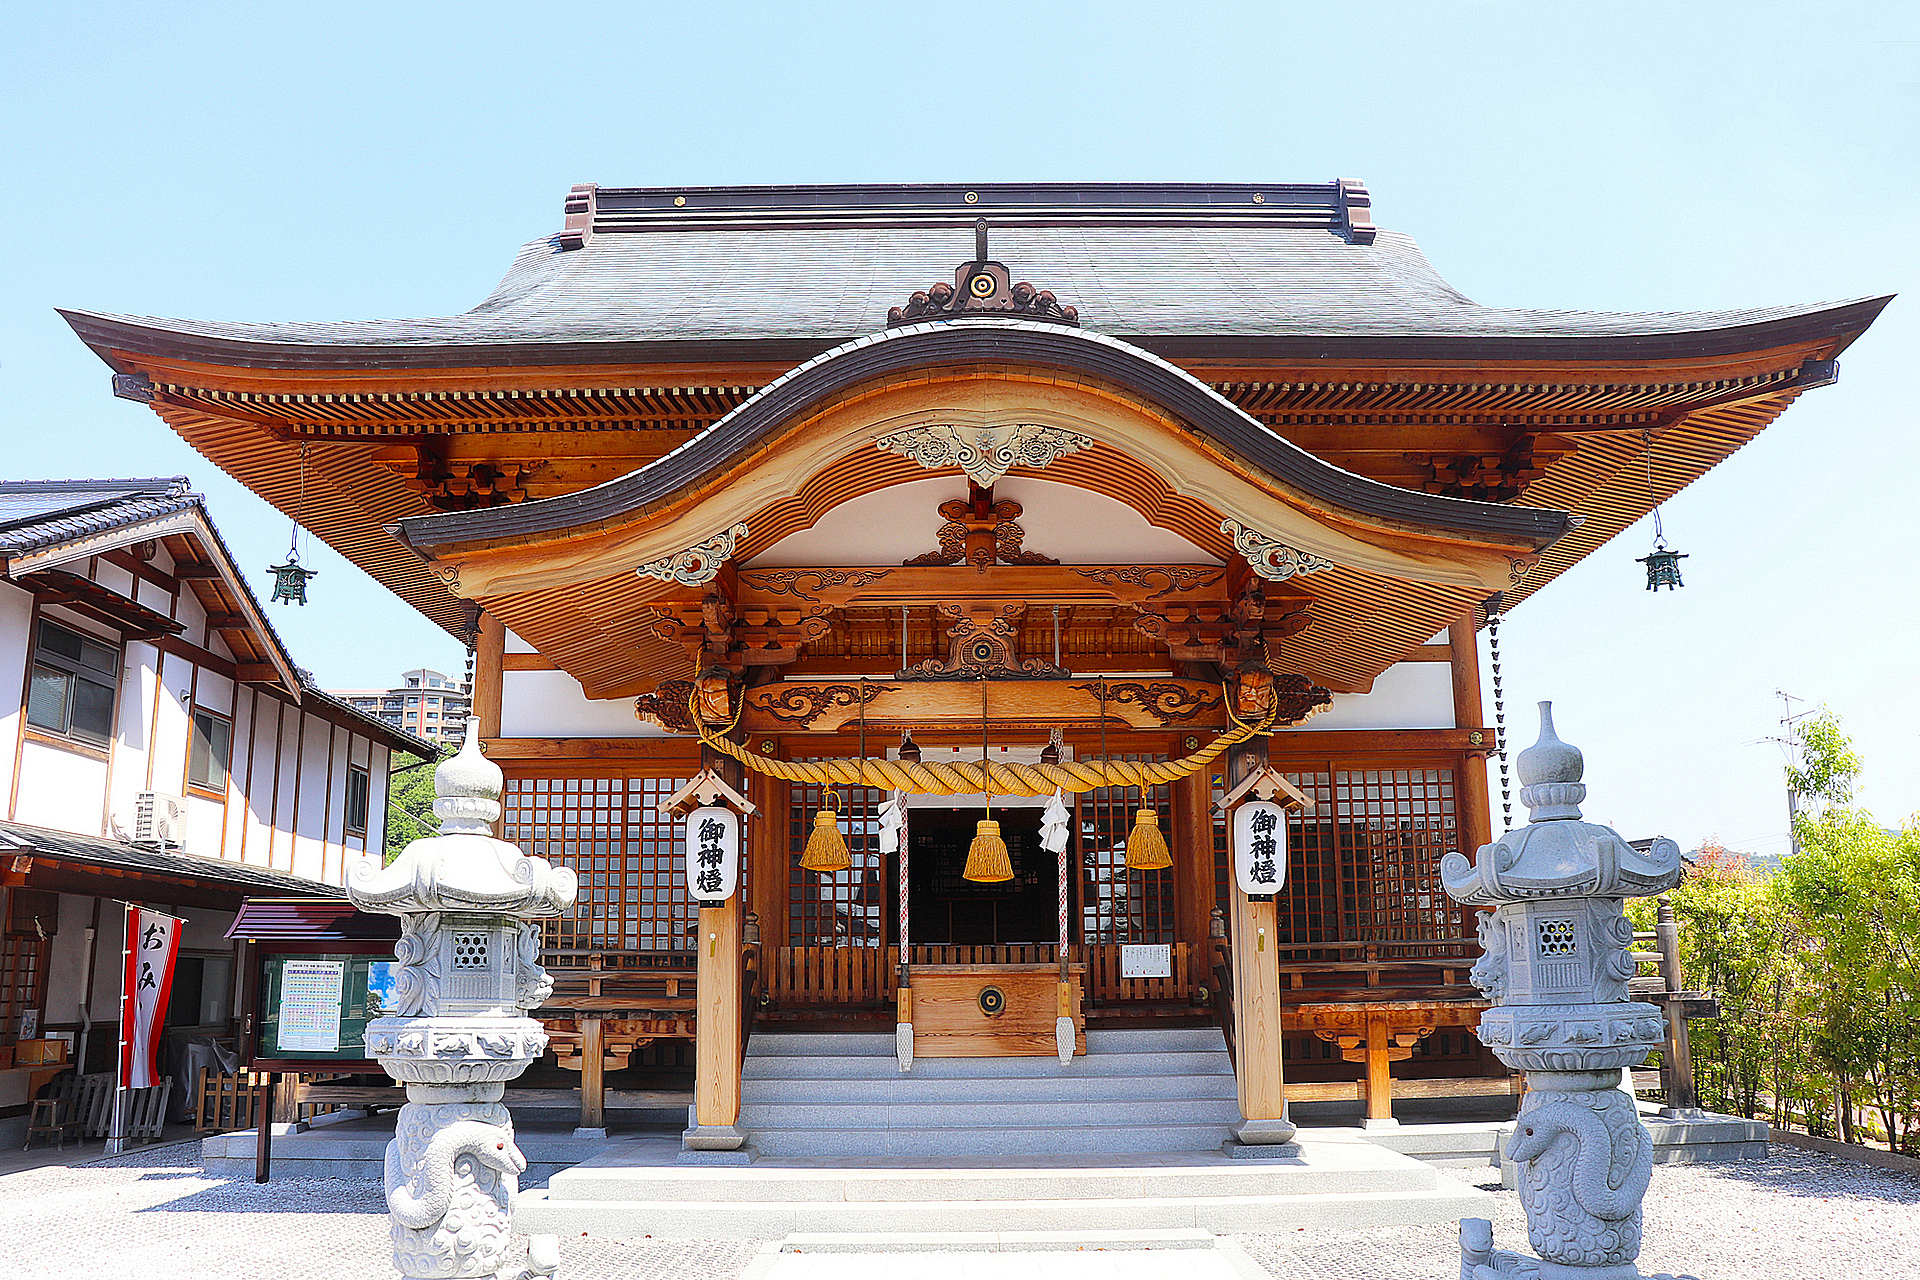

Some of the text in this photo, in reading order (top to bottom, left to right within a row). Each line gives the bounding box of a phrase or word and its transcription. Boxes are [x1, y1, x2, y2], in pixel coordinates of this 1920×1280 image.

[696, 817, 726, 894] 御神燈
[1249, 809, 1278, 885] 御神燈
[138, 922, 166, 1010] おみ
